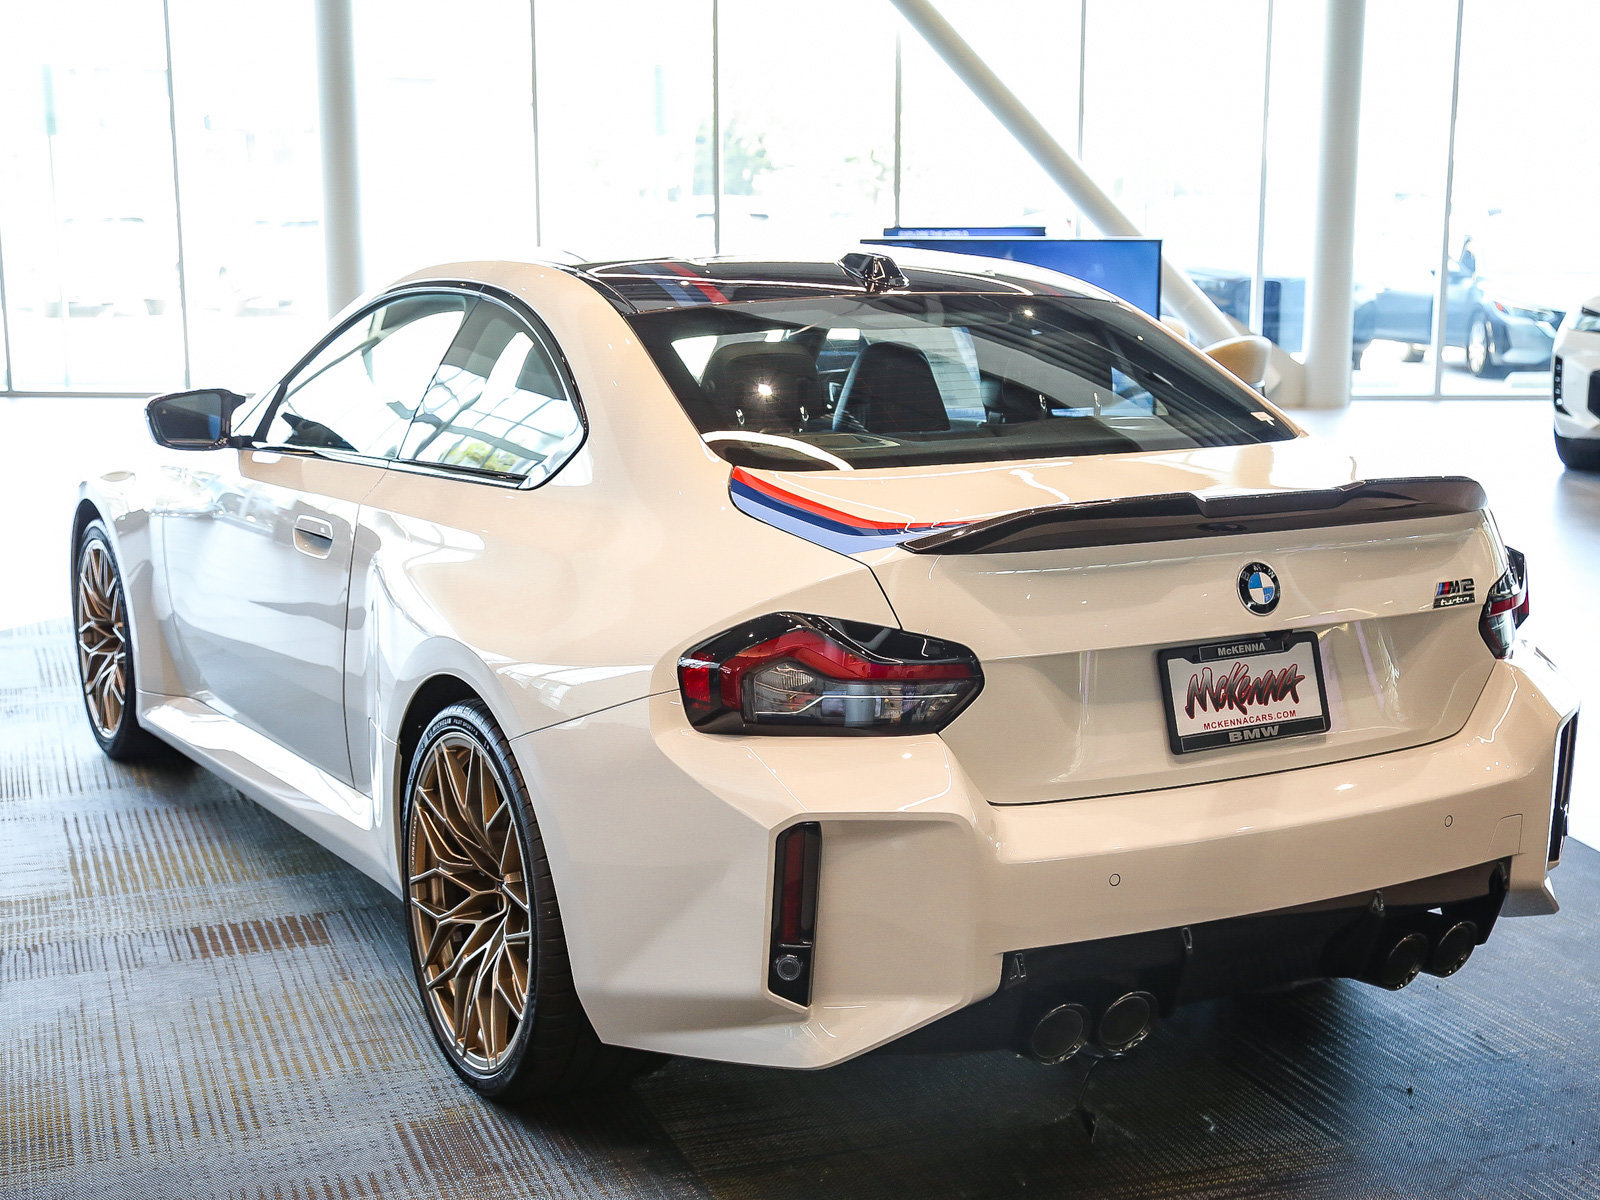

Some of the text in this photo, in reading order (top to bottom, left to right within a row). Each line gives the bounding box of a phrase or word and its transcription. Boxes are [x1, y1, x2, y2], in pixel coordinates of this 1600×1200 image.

[1437, 578, 1475, 596] M2
[1440, 596, 1470, 606] turbo
[1217, 642, 1266, 656] McKENNA
[1203, 709, 1297, 730] MCKENNACARS.COM
[1228, 725, 1279, 742] BMW
